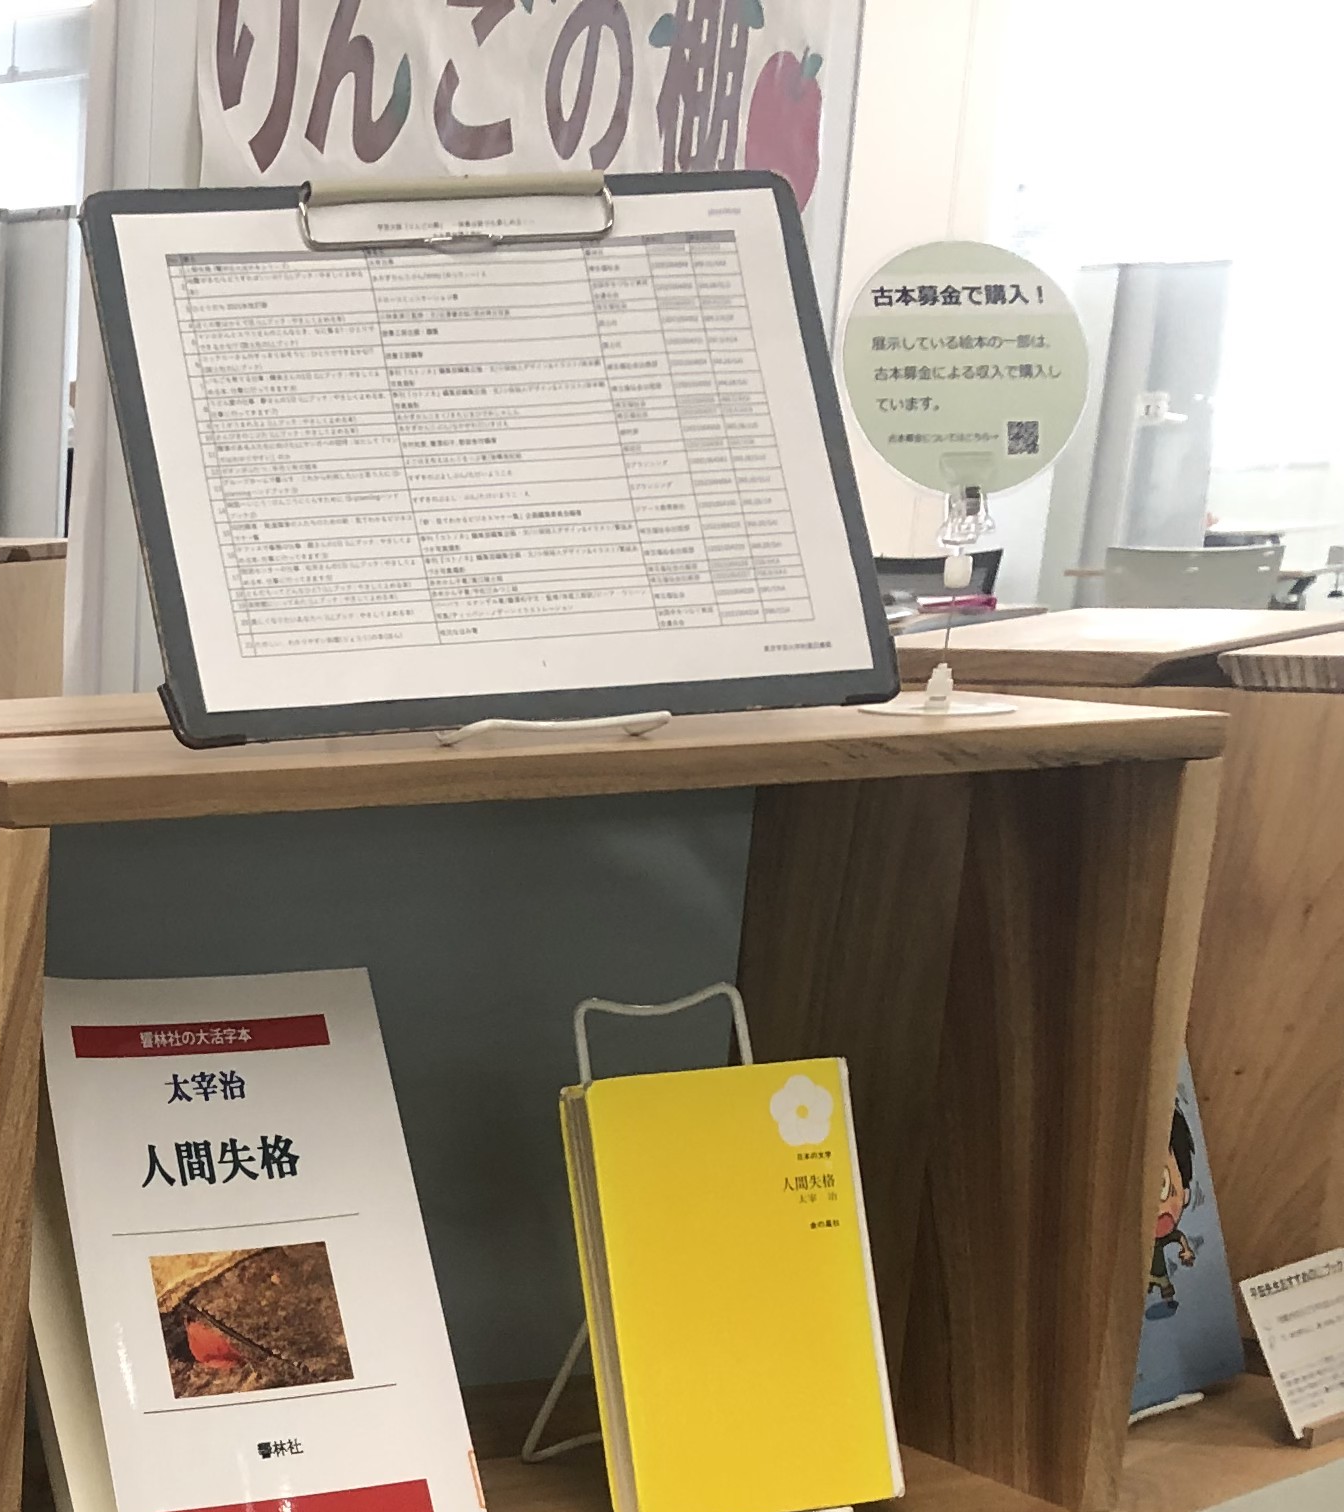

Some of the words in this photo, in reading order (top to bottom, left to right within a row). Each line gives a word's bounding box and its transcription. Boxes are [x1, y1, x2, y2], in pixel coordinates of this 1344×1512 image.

[872, 284, 1044, 307] 古本募金で購入！
[872, 333, 1050, 351] 展示している絵本の一部は、
[874, 364, 1060, 381] 古本募金による収入で購入し
[876, 395, 941, 413] ています。
[140, 1026, 251, 1049] 響林社の大活字本
[165, 1070, 246, 1104] 太宰治
[142, 1135, 300, 1188] 人間失格
[783, 1174, 835, 1192] 人間失格
